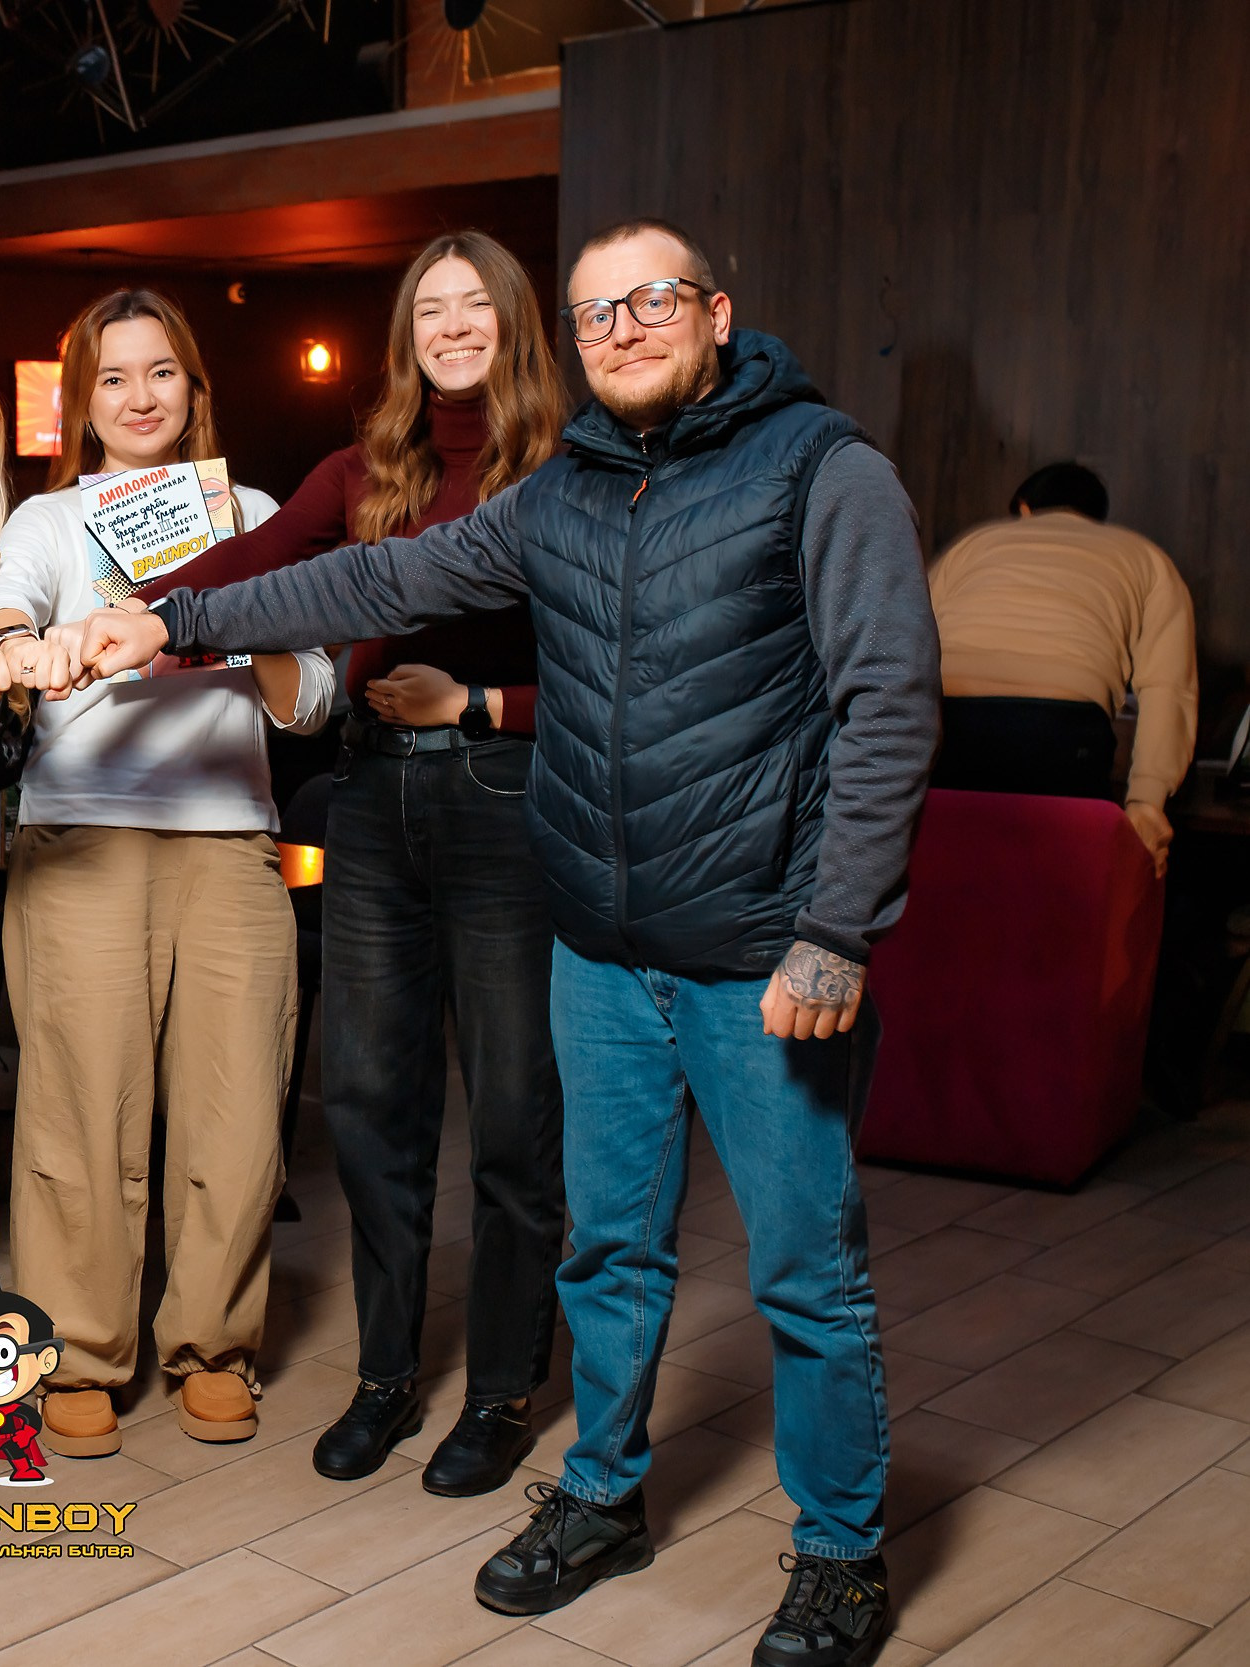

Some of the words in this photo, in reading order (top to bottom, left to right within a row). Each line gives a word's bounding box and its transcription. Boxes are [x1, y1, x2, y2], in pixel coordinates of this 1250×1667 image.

[92, 491, 149, 519] НАГРАЖДАЕТСЯ
[152, 475, 187, 494] КОМАНДА
[98, 467, 170, 508] ДИПЛОМОМ
[96, 521, 106, 535] В
[108, 511, 139, 531] дебрях
[116, 529, 159, 550] ЗАНЯВШАЯ
[173, 513, 199, 528] МЕСТО
[141, 526, 191, 550] СОСТЯЗАНИИ
[132, 532, 210, 580] BRAINBOY
